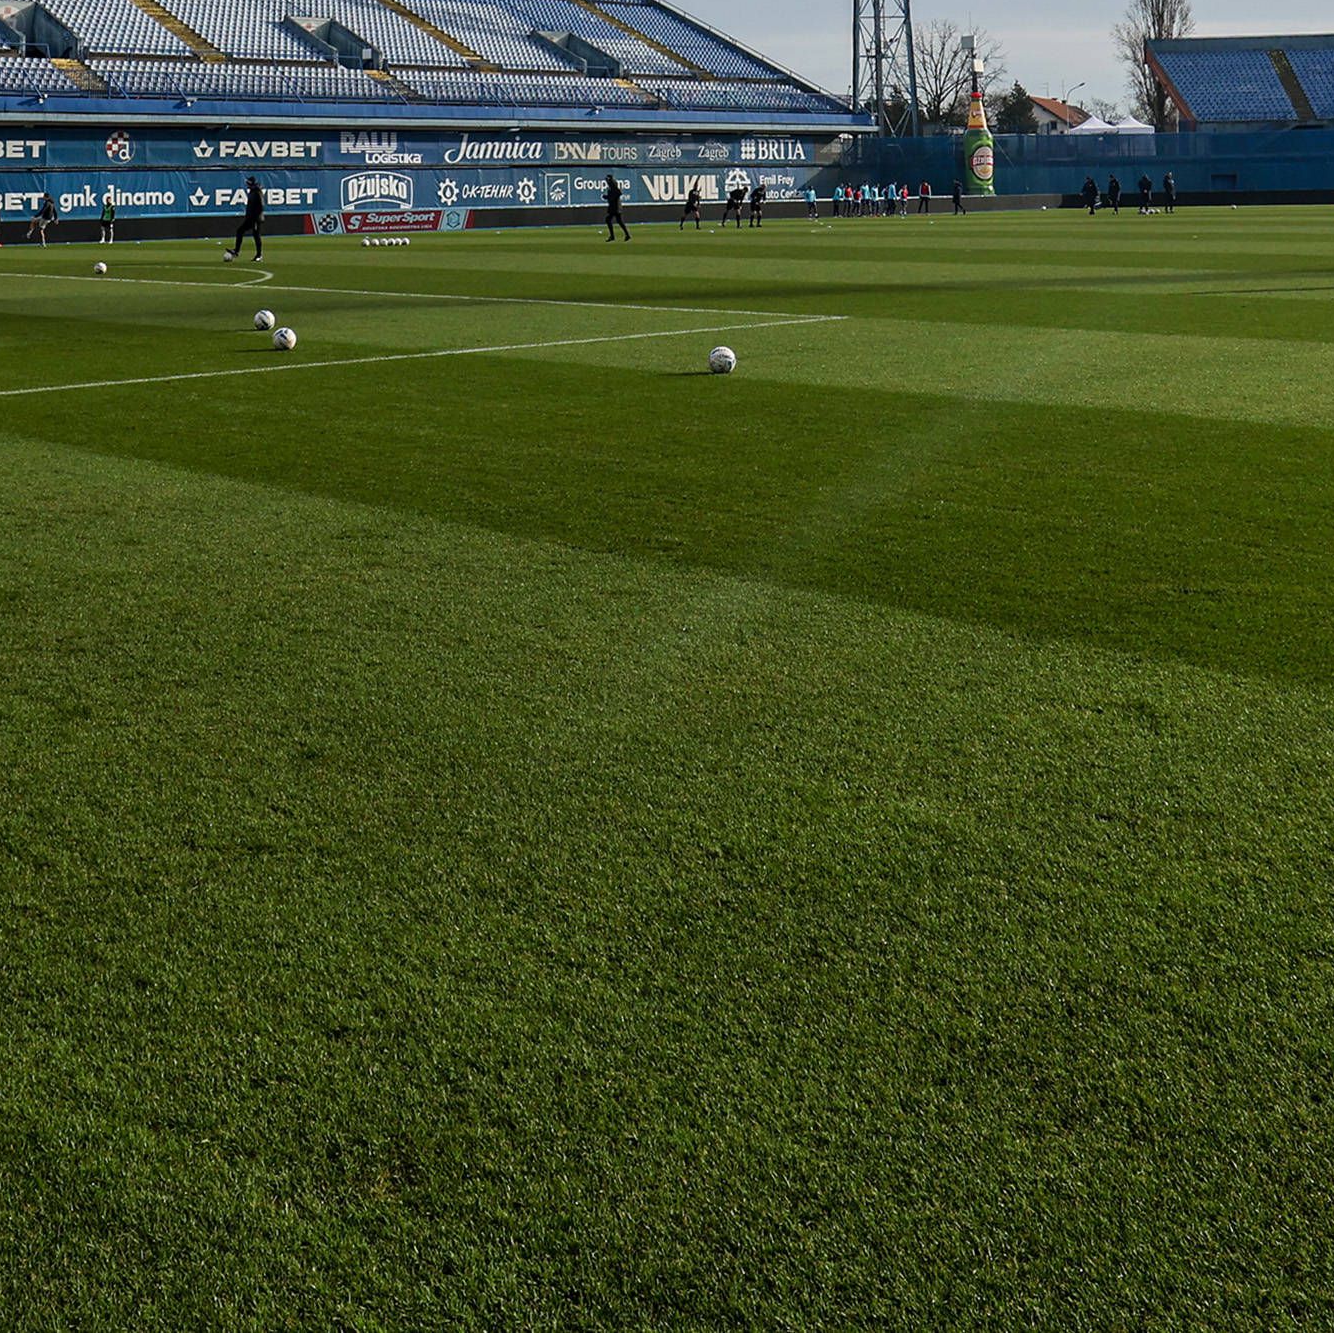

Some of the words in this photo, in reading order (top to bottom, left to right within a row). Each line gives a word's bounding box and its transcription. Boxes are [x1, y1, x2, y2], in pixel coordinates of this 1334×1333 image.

[219, 141, 322, 157] FAVBET
[340, 131, 397, 153] RALU
[444, 133, 543, 164] Jamnica
[758, 139, 806, 160] BRITA
[602, 147, 638, 160] TOURS
[648, 145, 682, 161] Zagreb
[698, 145, 729, 161] Zagreb
[348, 174, 407, 202] Ožujsko
[574, 177, 631, 192] Groupma
[759, 176, 776, 186] Emil
[778, 176, 795, 187] Frey
[59, 185, 97, 212] gnk
[102, 185, 175, 207] dinamo
[215, 188, 318, 205] FABET
[763, 189, 779, 199] uto
[366, 211, 436, 224] SuperSport
